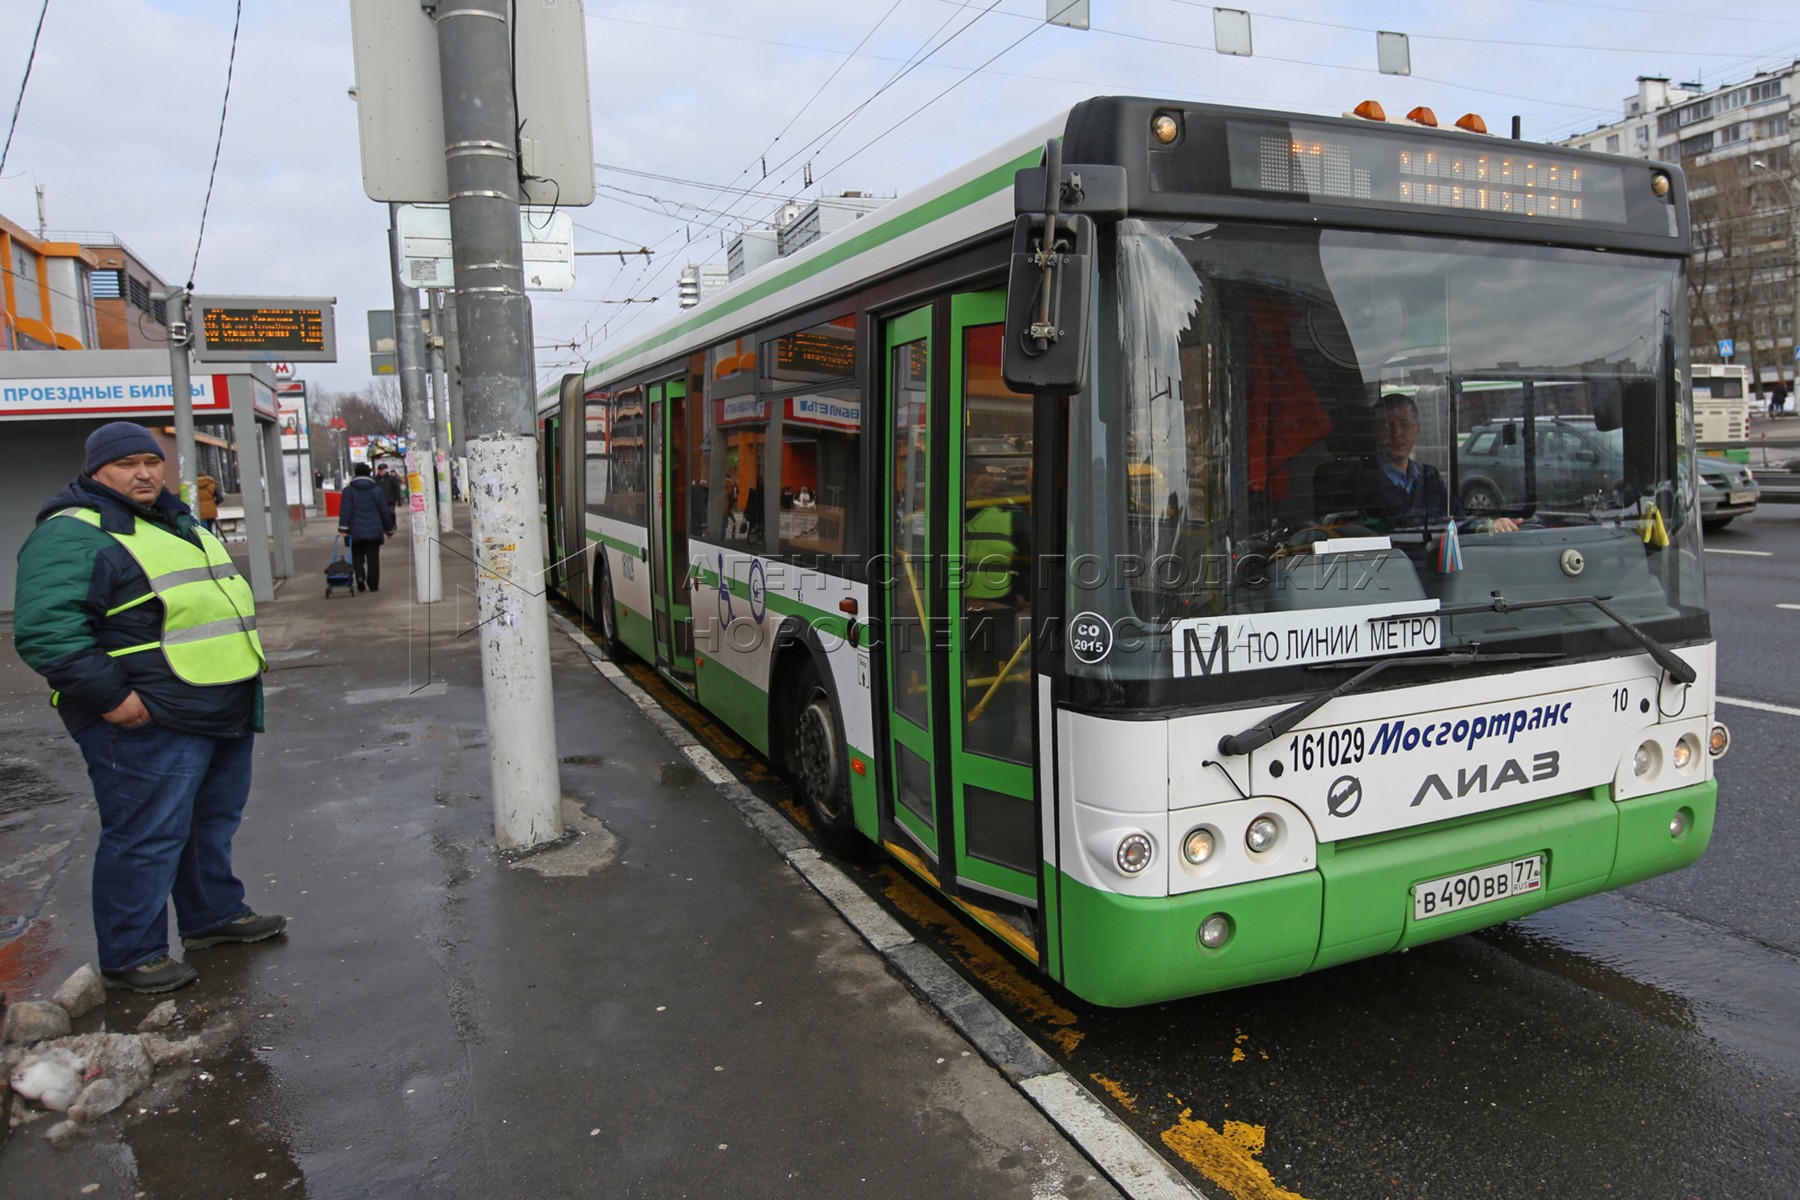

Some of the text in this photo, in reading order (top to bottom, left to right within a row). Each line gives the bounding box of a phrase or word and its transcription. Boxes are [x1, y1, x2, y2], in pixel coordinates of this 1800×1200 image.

[4, 383, 205, 403] ПРОЕЗДНЫЕ БИЛЕЫ
[1074, 638, 1104, 653] 2015
[1183, 617, 1437, 676] М ПО ЛИНИИ МЕТРО
[1612, 688, 1628, 712] 10
[1368, 702, 1572, 757] Мосгортранс
[1289, 726, 1365, 773] 161029
[1410, 750, 1559, 807] ЛИАЗ
[1515, 860, 1534, 883] 77
[1514, 881, 1528, 891] RUS
